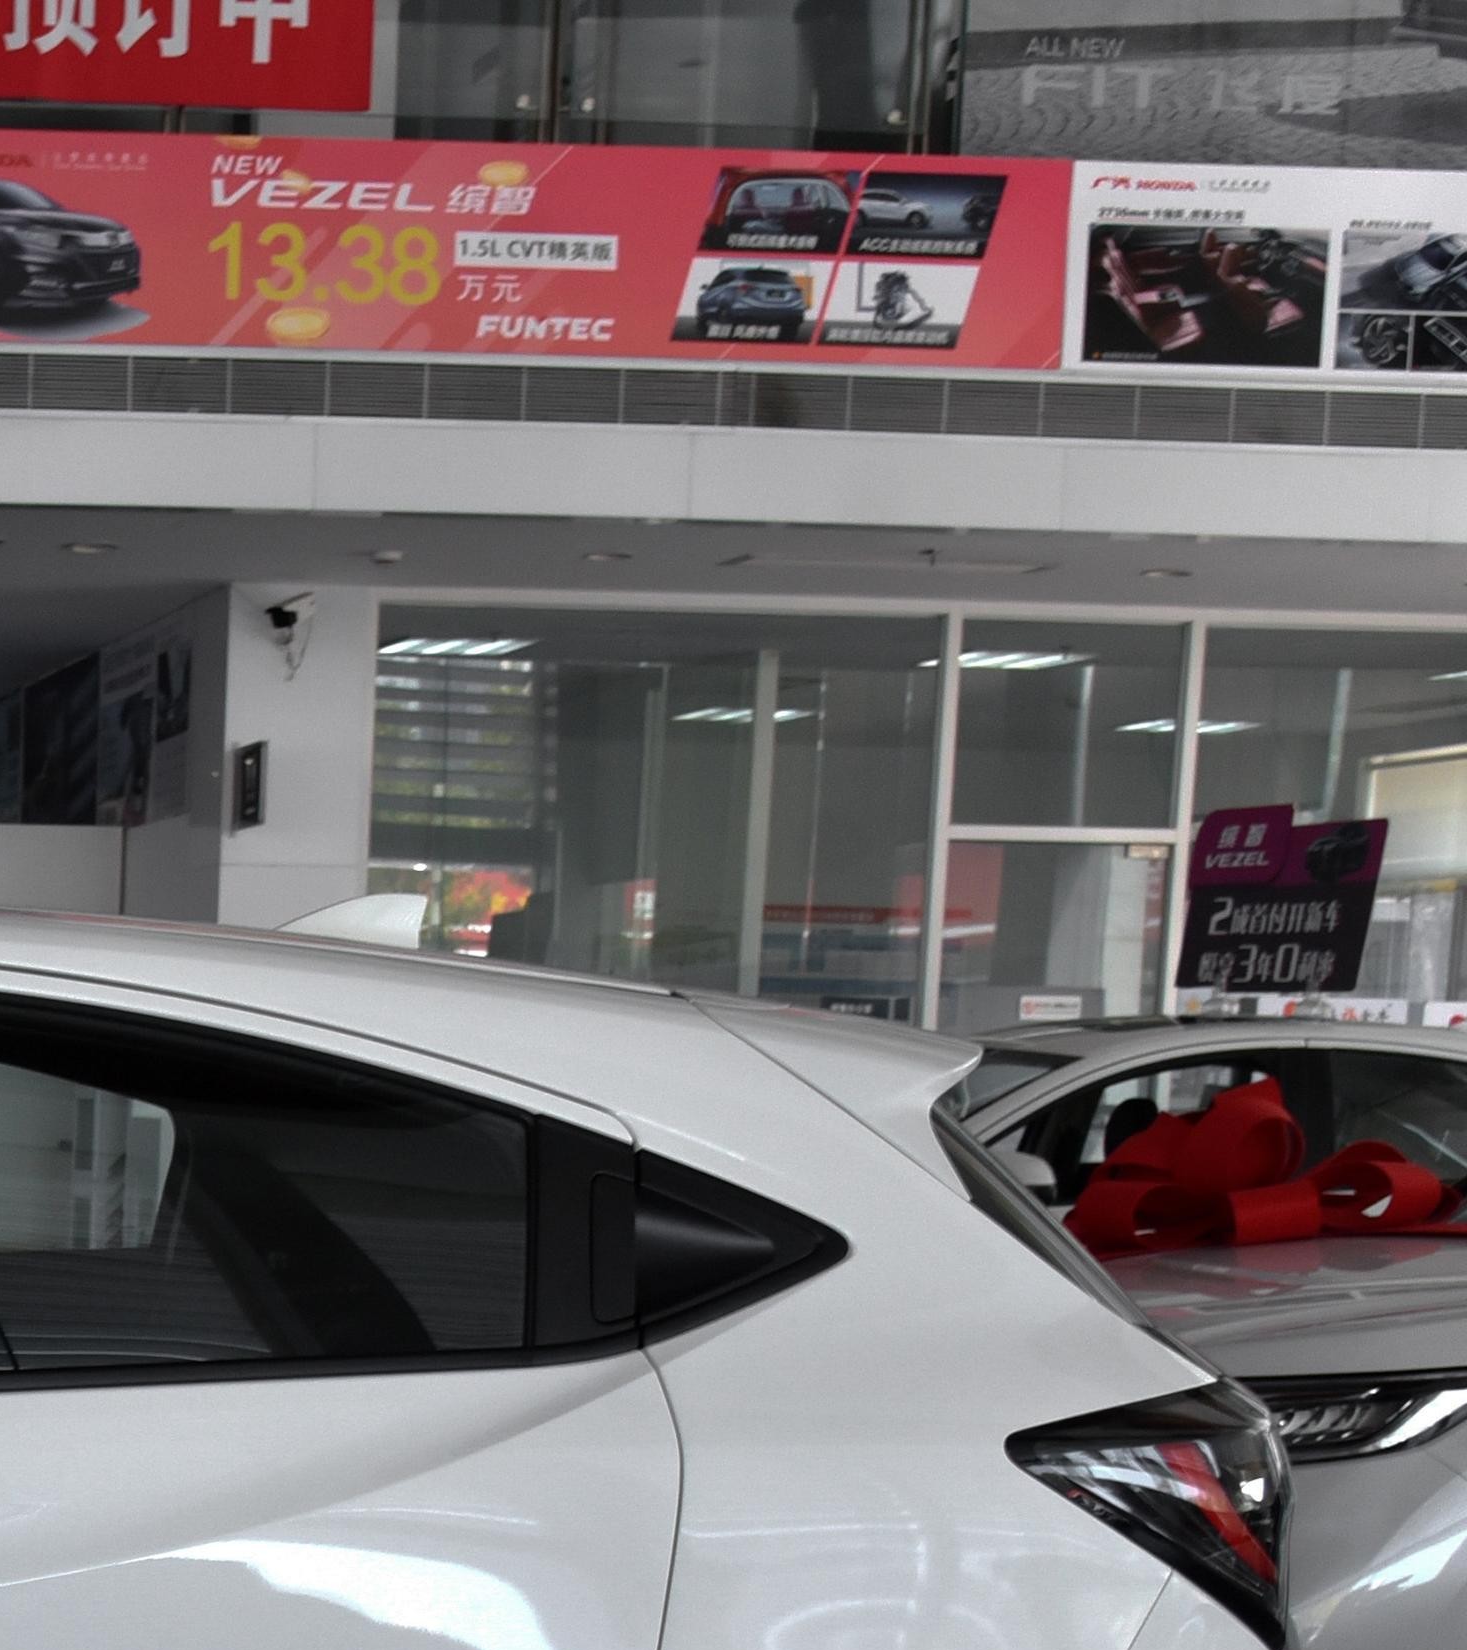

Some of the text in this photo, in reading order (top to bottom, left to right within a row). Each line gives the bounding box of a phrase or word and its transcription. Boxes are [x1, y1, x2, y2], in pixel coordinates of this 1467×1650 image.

[1025, 37, 1126, 58] ALL NEW
[1021, 64, 1174, 109] FIT
[211, 155, 283, 175] NEW
[210, 178, 536, 216] VEZEL 缤智
[459, 238, 500, 258] 1.5L
[207, 221, 441, 306] 13.38
[456, 274, 523, 303] 万元
[476, 315, 615, 342] FUNTEC
[1204, 852, 1270, 870] VEZEL
